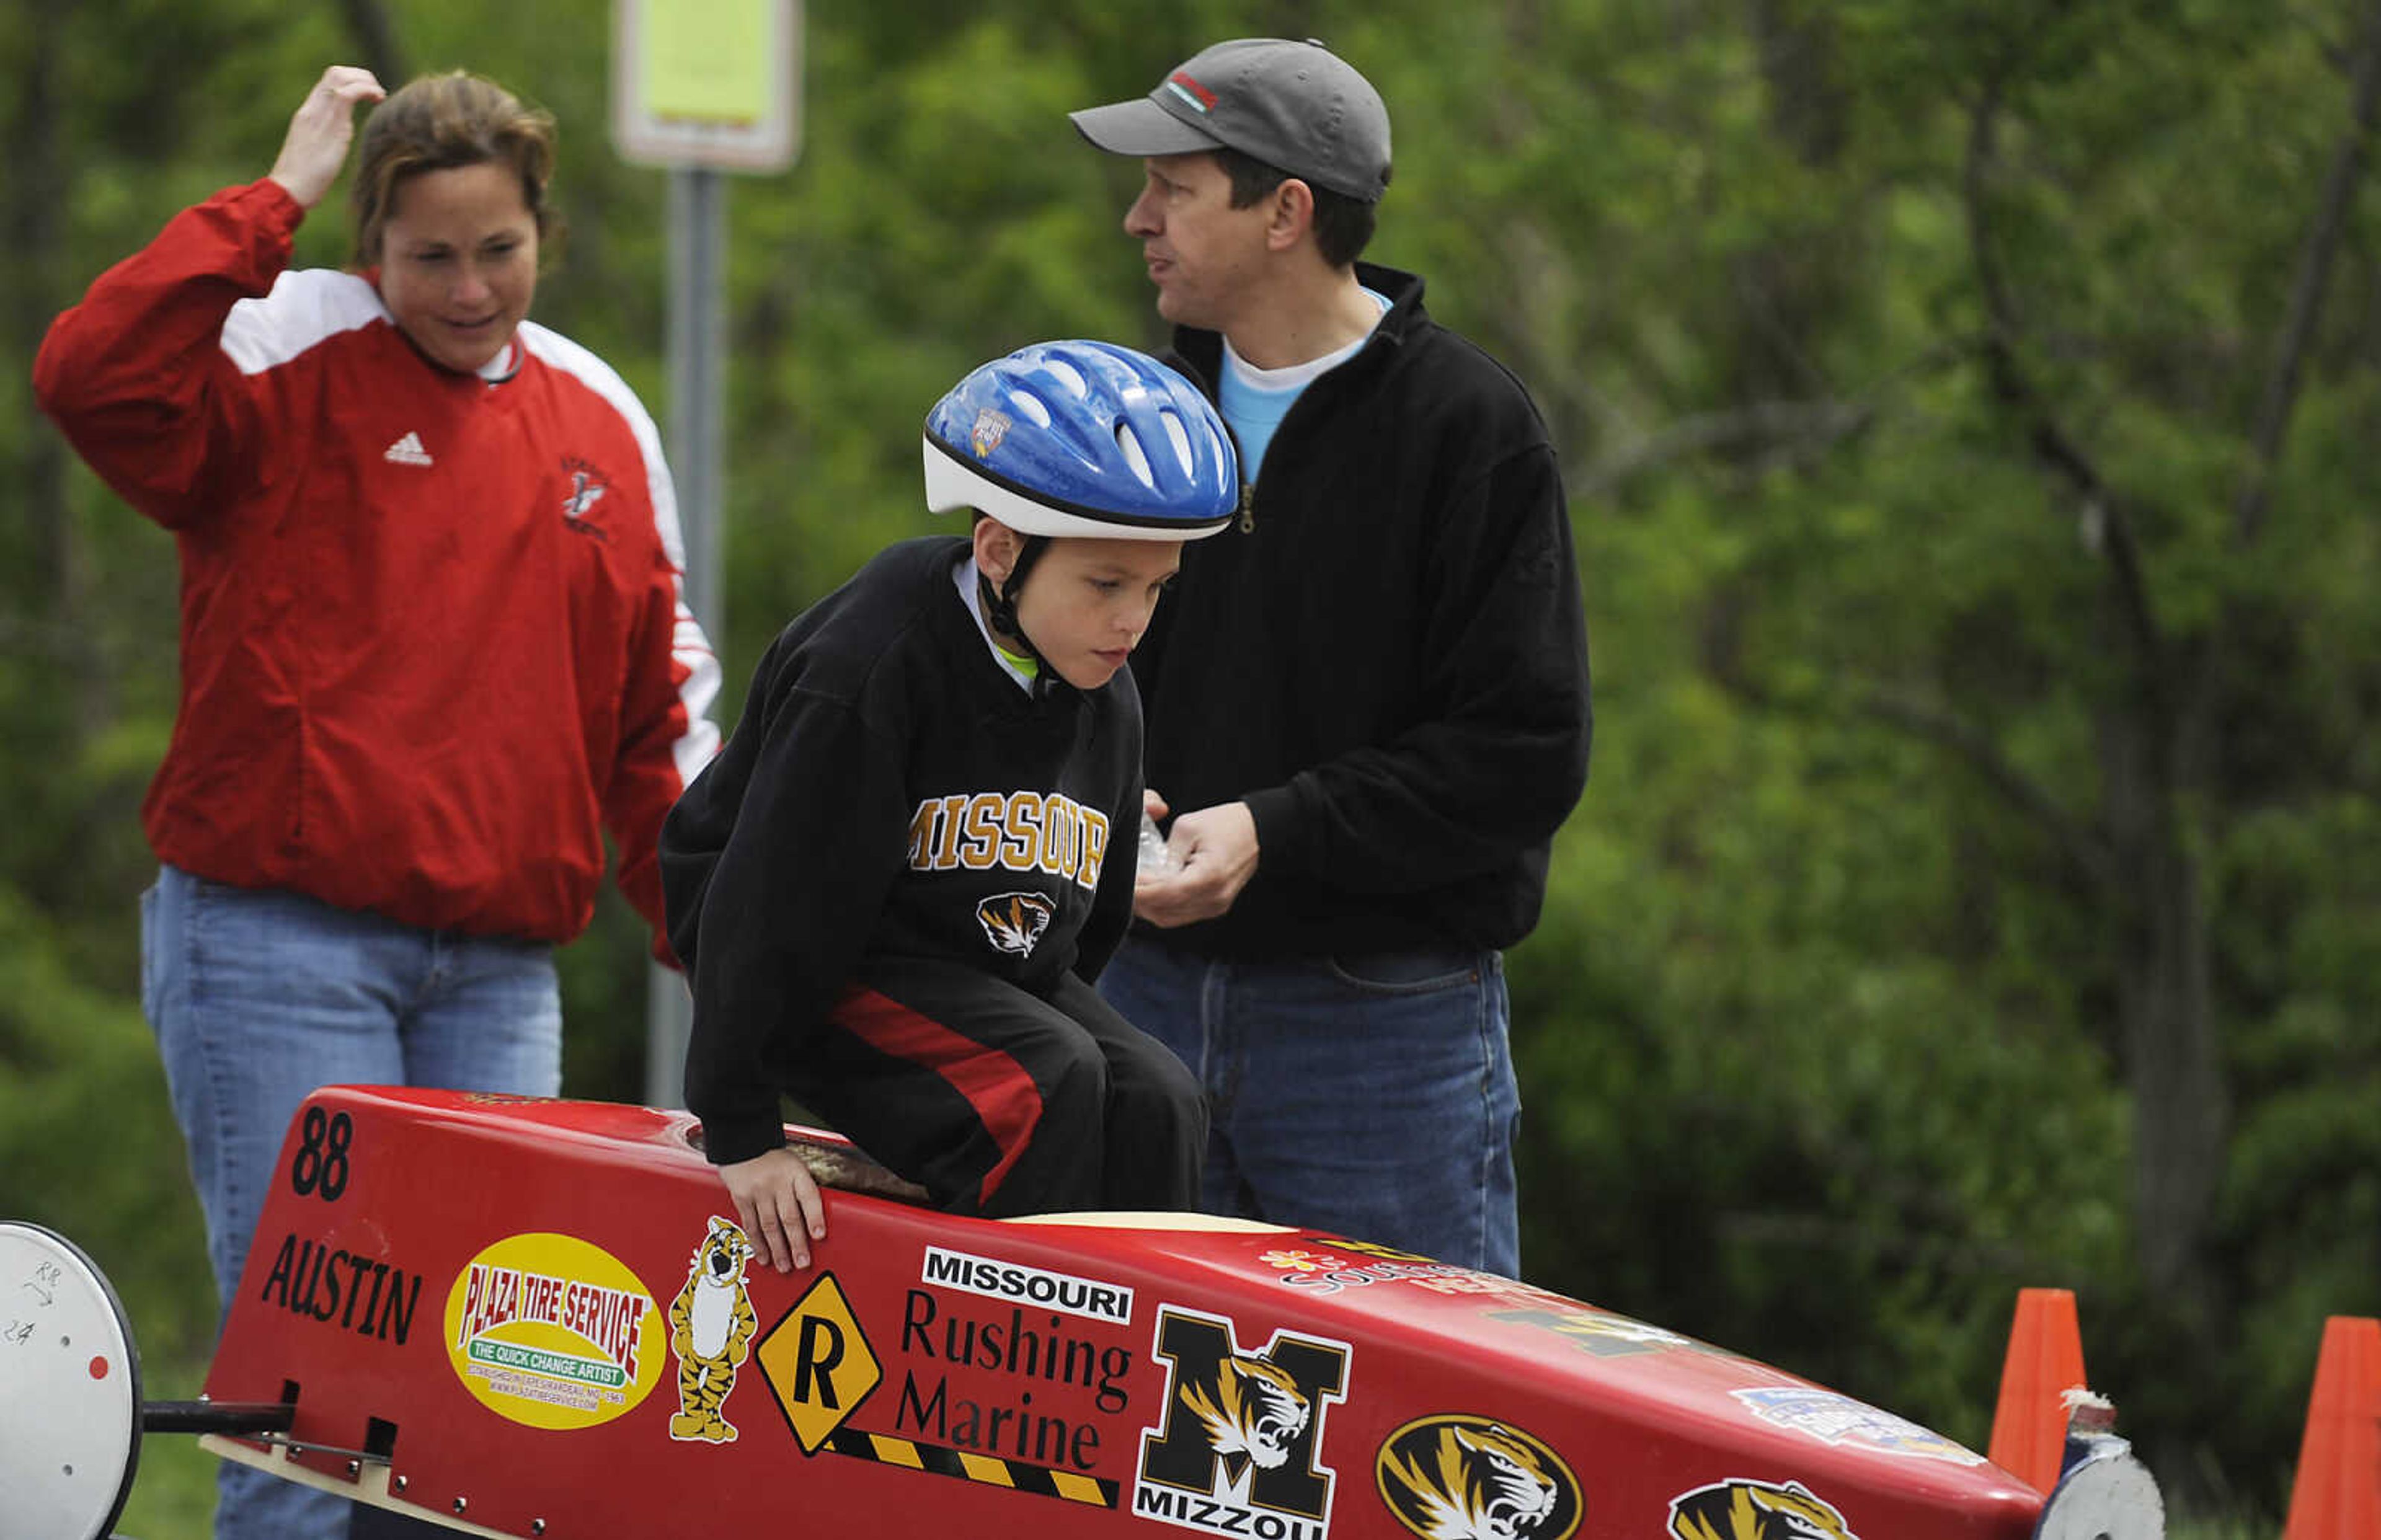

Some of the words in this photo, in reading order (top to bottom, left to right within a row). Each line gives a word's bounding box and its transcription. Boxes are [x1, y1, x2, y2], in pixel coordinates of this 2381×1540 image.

[907, 790, 1109, 893] MISSOUR
[292, 1107, 352, 1201] 88
[262, 1234, 422, 1345] AUSTIN
[459, 1265, 520, 1345] PLAZA
[523, 1273, 562, 1322] TIRE
[562, 1283, 644, 1381] SERVICE
[926, 1253, 1130, 1319] MISSOURI
[475, 1342, 494, 1360] THE
[496, 1346, 530, 1368] QUICK
[530, 1354, 577, 1378] CHANGE
[577, 1366, 619, 1384] ARTIST
[793, 1314, 845, 1410] R
[901, 1289, 1132, 1414] Rushing
[895, 1369, 1100, 1470] Marine
[1136, 1485, 1322, 1540] MIZZOU
